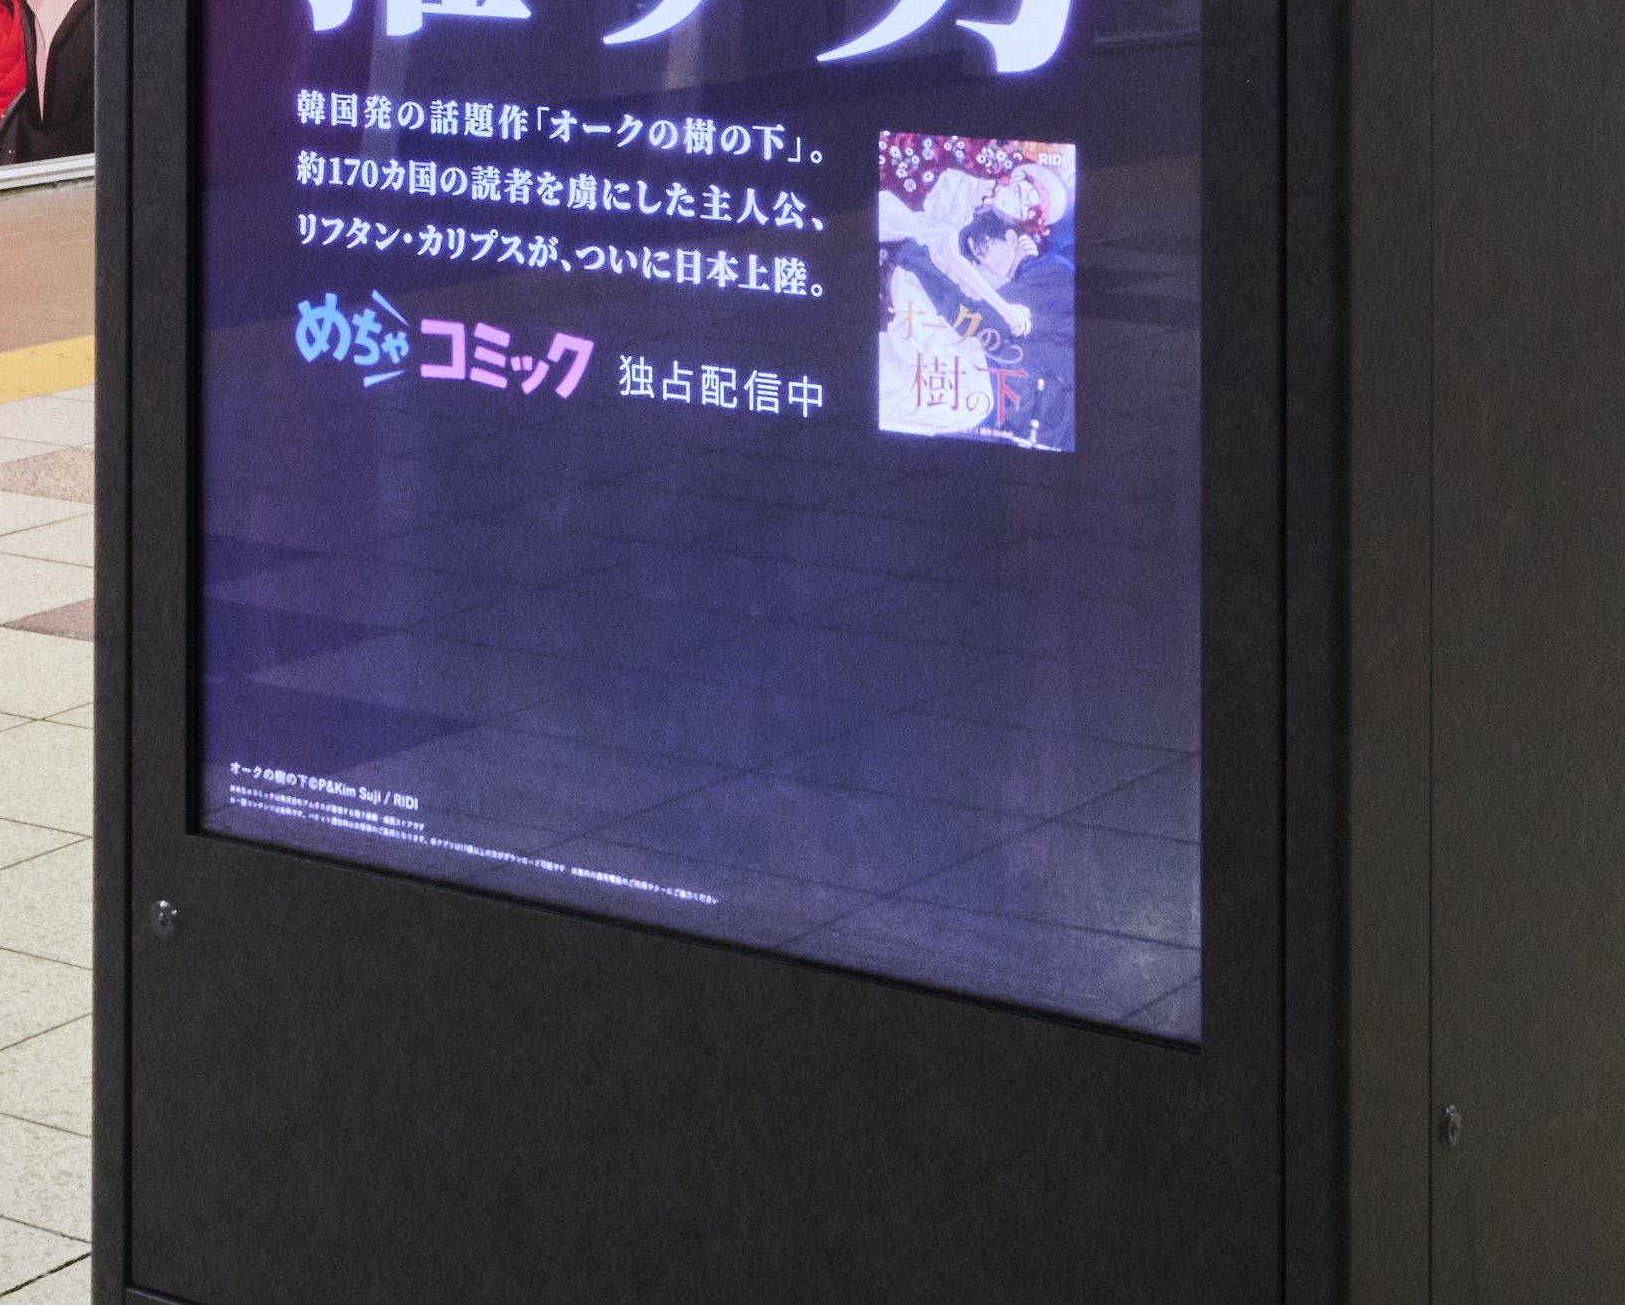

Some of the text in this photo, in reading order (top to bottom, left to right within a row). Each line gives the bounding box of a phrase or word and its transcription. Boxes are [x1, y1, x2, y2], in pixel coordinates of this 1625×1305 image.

[296, 88, 825, 166] 韓国発の話題作「オークの樹の下」。
[1038, 152, 1067, 167] RIDI
[297, 211, 825, 298] リフタン・カリプスが、ついに日本上陸。
[617, 353, 824, 420] 独占配信中
[359, 785, 381, 805] Suji
[393, 793, 419, 811] RIDI
